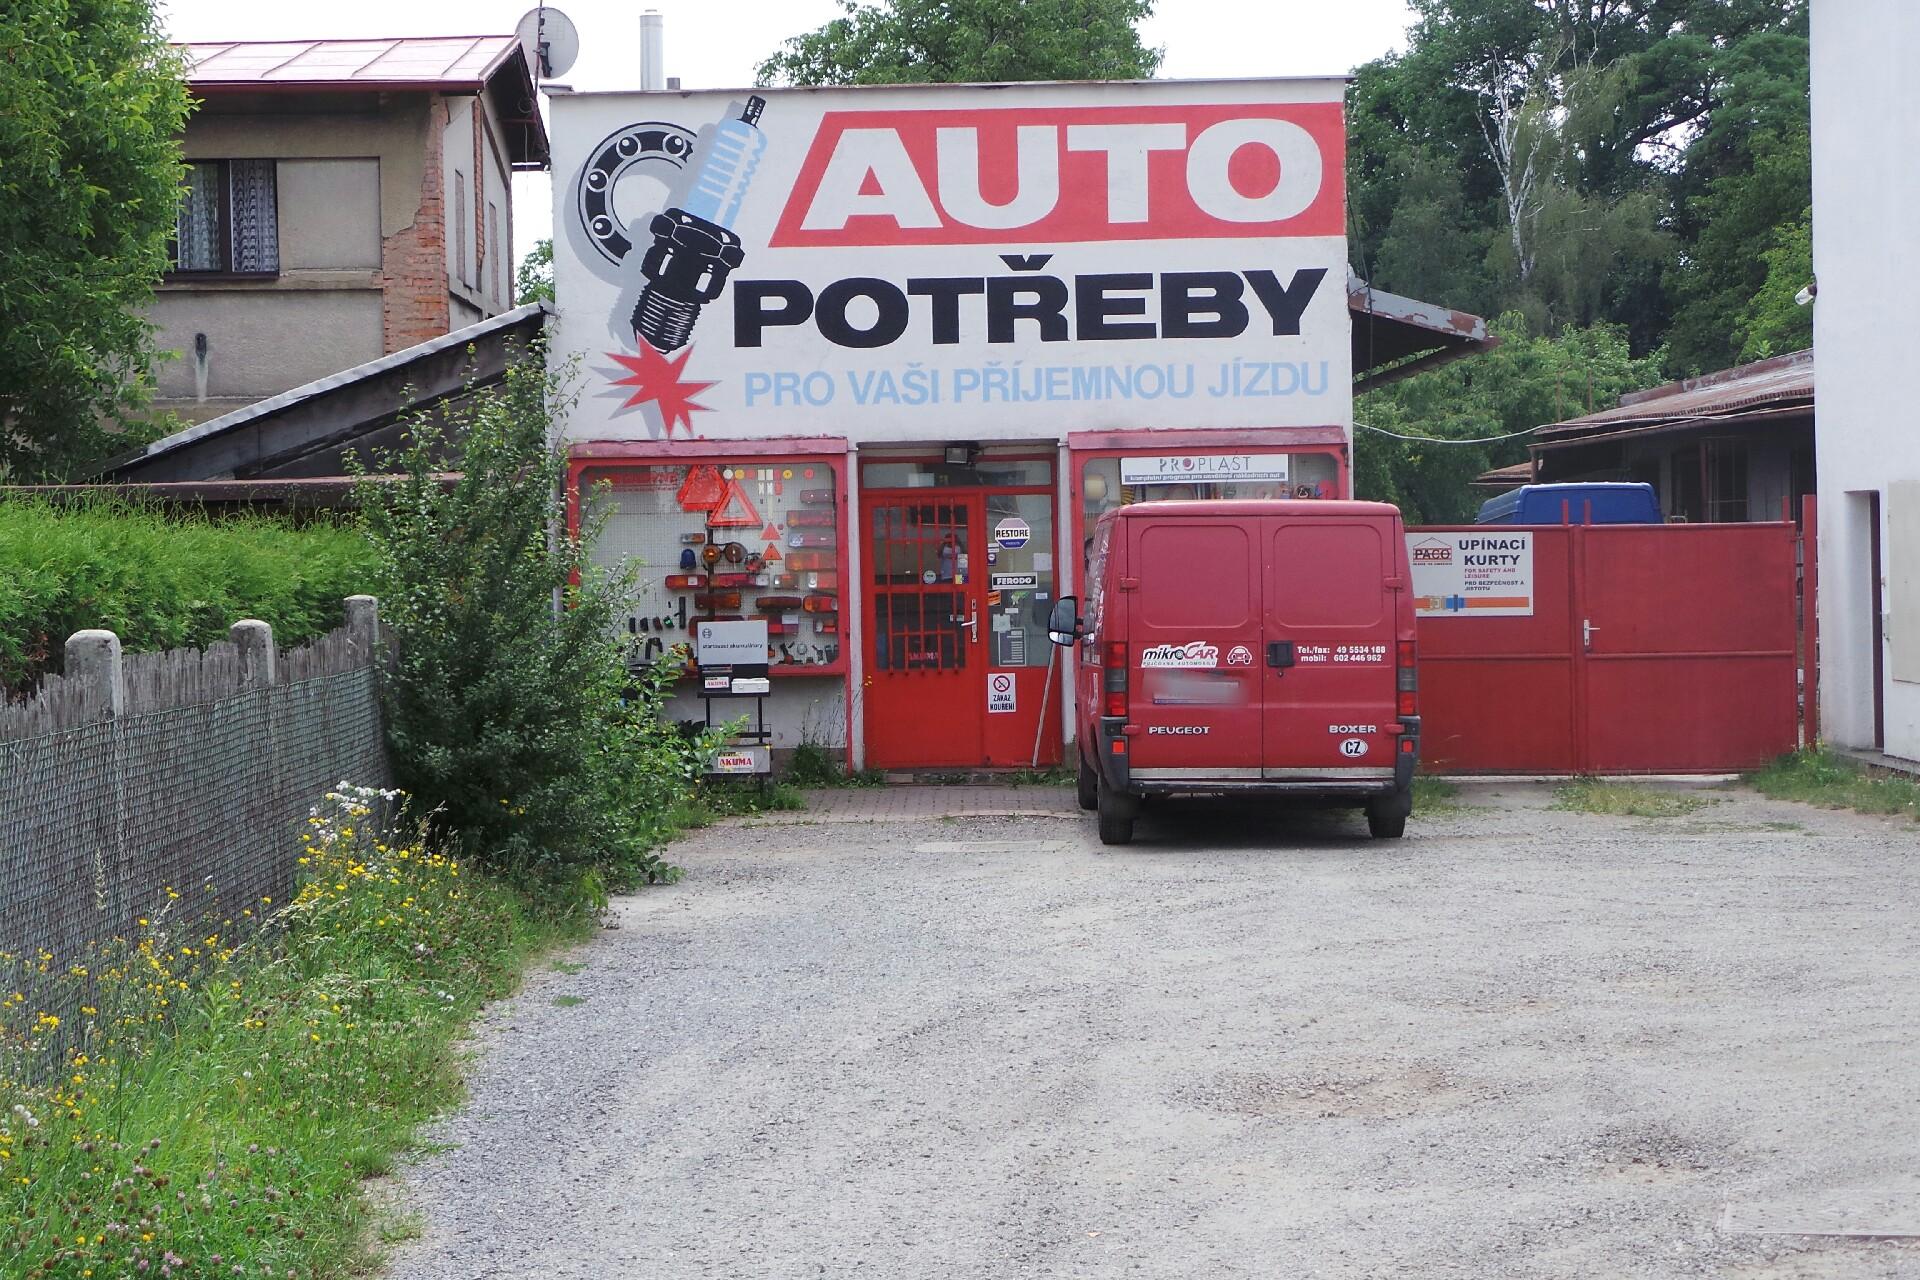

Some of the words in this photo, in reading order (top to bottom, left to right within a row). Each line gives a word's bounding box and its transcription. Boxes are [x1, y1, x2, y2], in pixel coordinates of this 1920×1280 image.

[800, 117, 1324, 231] AUTO
[733, 253, 1329, 348] POTŘEBY
[745, 370, 836, 407] PRO
[846, 362, 940, 406] VAŠI
[953, 359, 1195, 404] PŘÍJEMNOU
[1207, 356, 1329, 397] JÍZDU
[1159, 456, 1252, 473] PROPLAST
[995, 529, 1029, 538] RESTORE
[1459, 538, 1525, 550] UPÍNACÍ
[1414, 549, 1451, 560] PACO
[1464, 555, 1520, 565] KURTY
[996, 577, 1033, 585] FERODO
[1336, 645, 1347, 654] 49
[1300, 654, 1328, 662] mobil:
[1333, 654, 1349, 662] 602
[1148, 726, 1211, 735] PEUGEOT
[1328, 725, 1377, 734] BOXER
[1345, 741, 1361, 755] CZ
[719, 758, 753, 766] AKUMA
